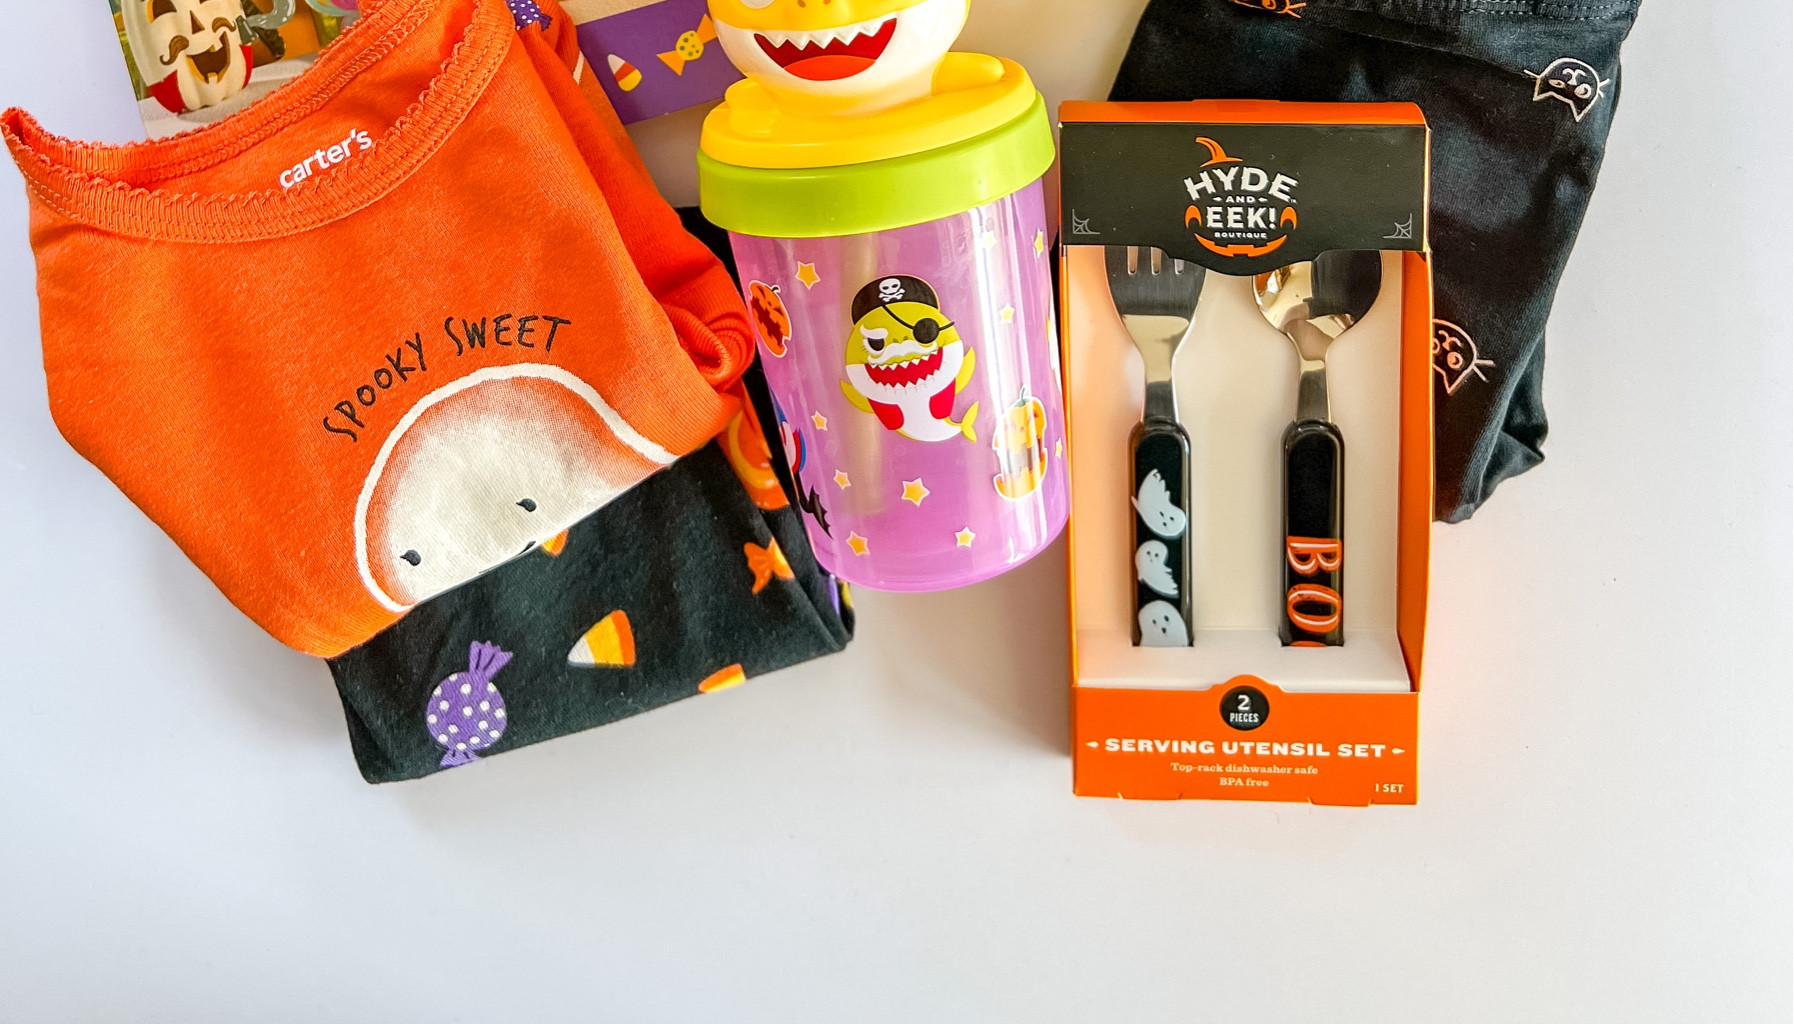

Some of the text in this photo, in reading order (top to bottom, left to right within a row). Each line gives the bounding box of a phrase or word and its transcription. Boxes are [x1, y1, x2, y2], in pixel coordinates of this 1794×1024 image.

[279, 127, 374, 189] carter's
[1183, 166, 1299, 202] HYDE
[1225, 195, 1256, 203] AND
[1206, 206, 1276, 230] EEK!
[1214, 231, 1267, 239] BOUTIQUE
[322, 313, 572, 443] SPOOKY SWEET
[1286, 536, 1343, 647] BO
[1236, 694, 1251, 711] 2
[1229, 713, 1259, 723] PIECES
[1105, 738, 1386, 757] SERVING UTENSIL SET
[1170, 762, 1319, 775] Top-rack dishwasher safe
[1219, 777, 1270, 787] BPA free
[1382, 784, 1405, 793] SET
